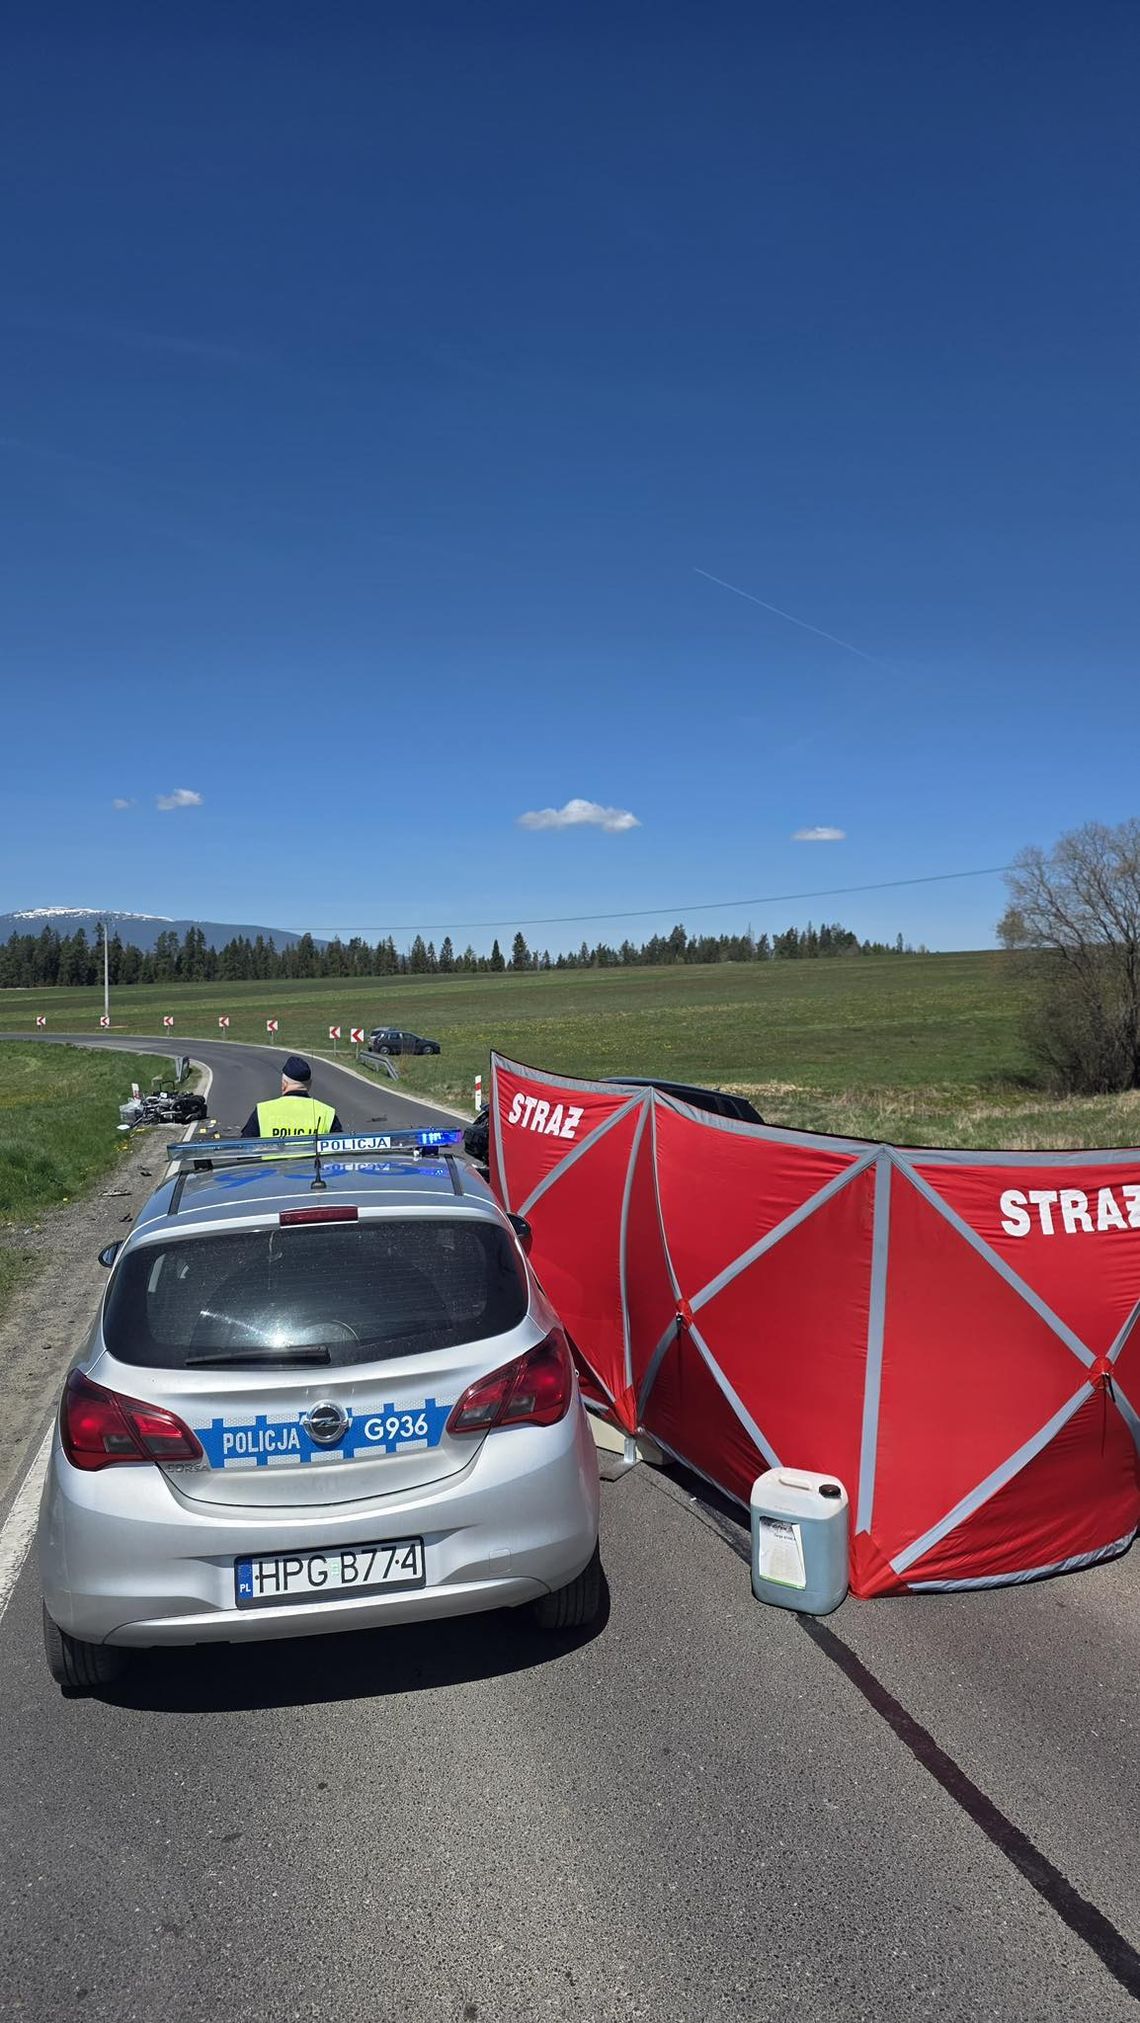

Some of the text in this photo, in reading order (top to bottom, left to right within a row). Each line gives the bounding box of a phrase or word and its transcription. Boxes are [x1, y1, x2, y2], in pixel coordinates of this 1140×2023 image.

[508, 1093, 584, 1139] STRAŻ
[320, 1138, 387, 1151] POLICJA
[223, 1413, 428, 1454] POLICJA G936
[240, 1583, 251, 1593] PL
[258, 1544, 418, 1593] HPG B774
